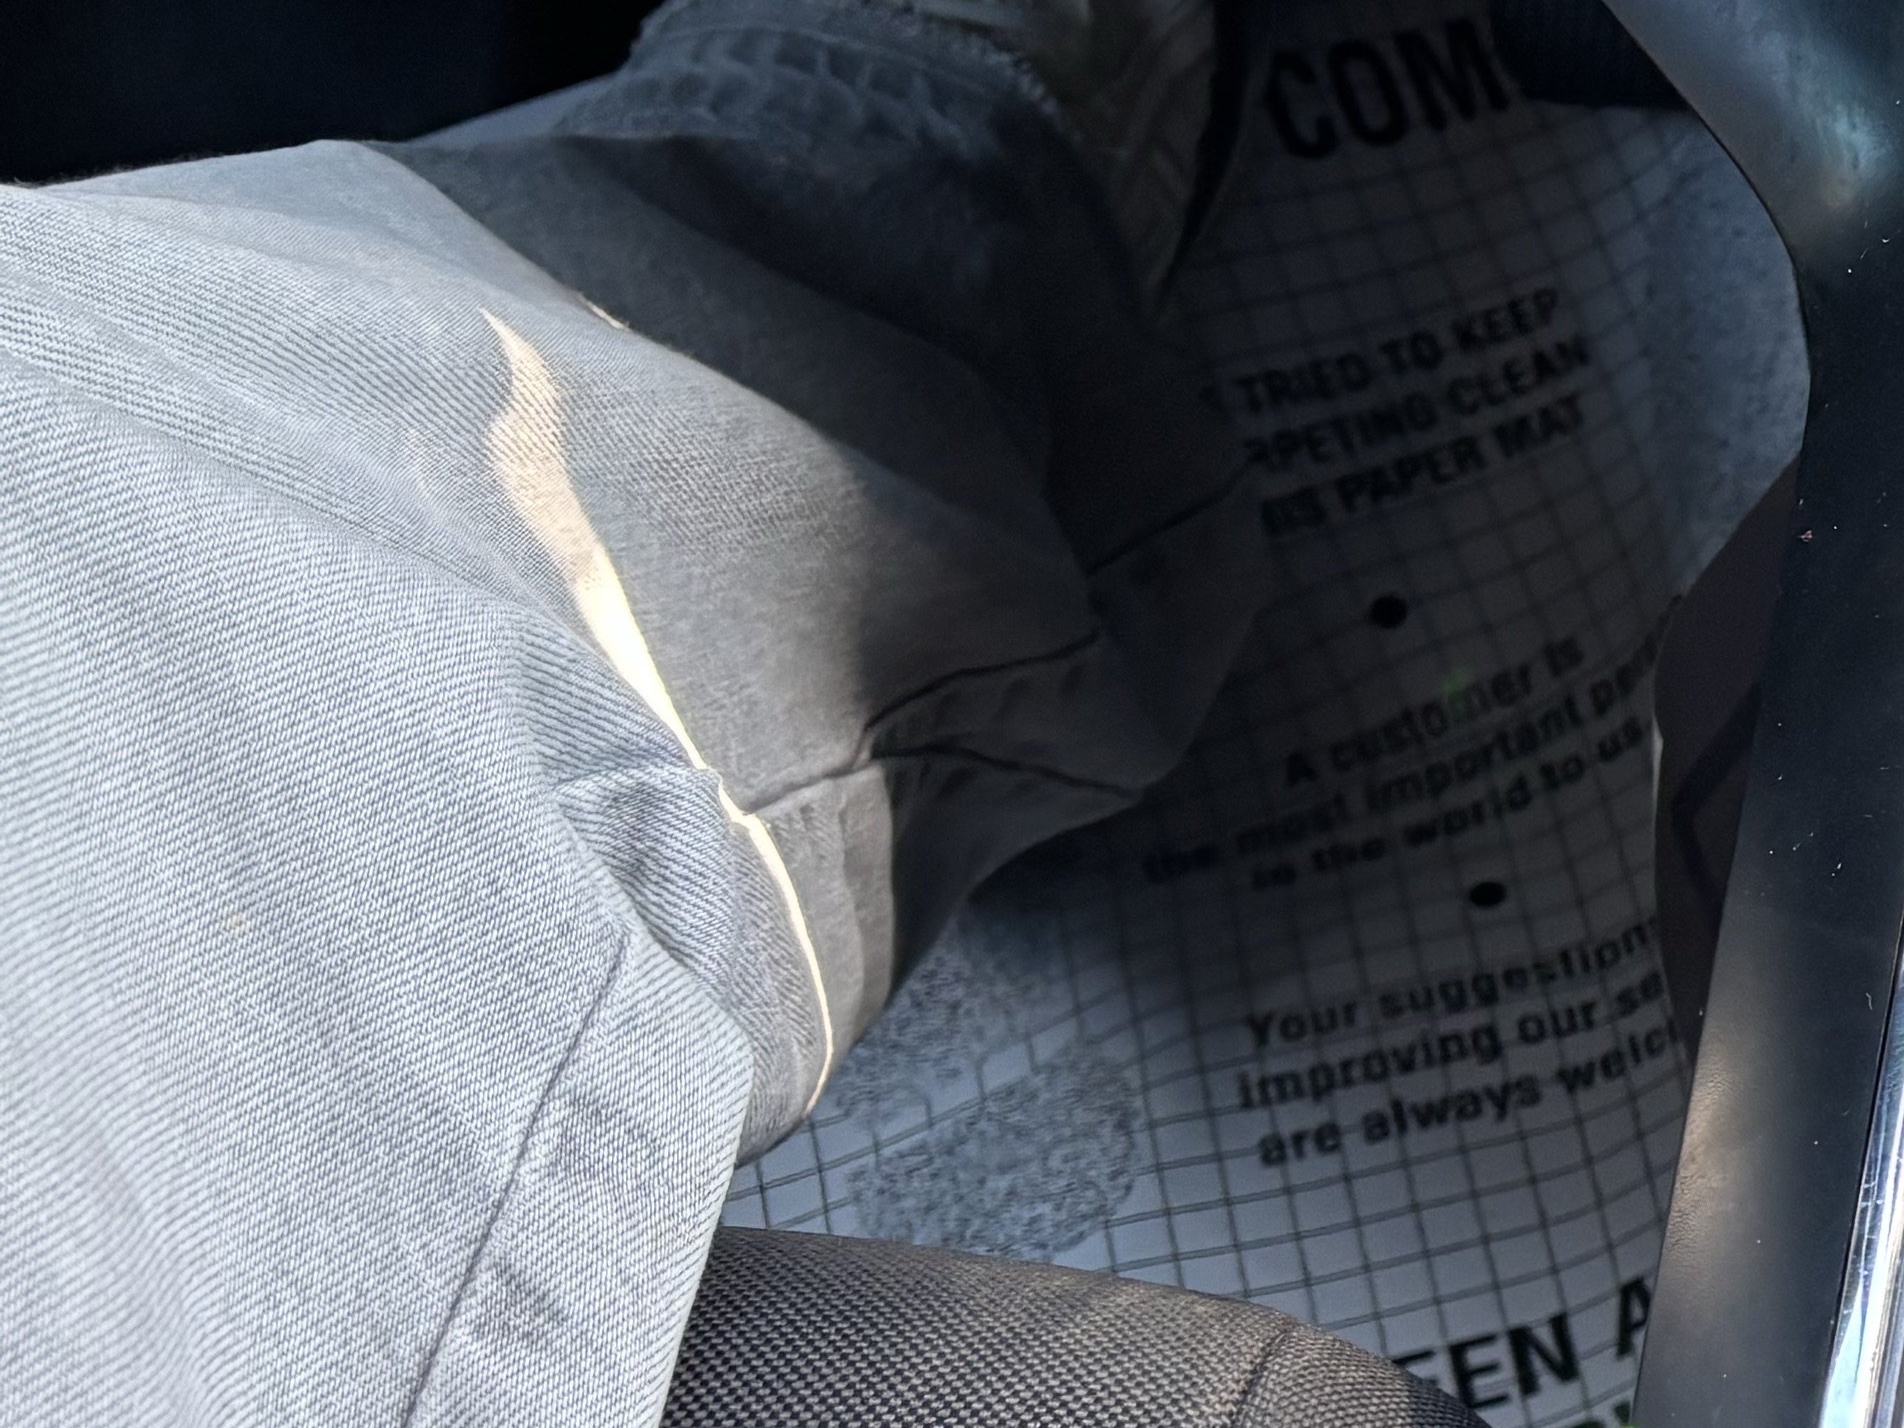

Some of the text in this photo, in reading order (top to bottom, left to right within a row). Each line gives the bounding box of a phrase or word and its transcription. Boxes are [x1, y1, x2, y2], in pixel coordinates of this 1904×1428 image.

[1231, 351, 1373, 416] TRIED
[1377, 329, 1446, 373] TO
[1450, 286, 1560, 349] KEEP
[1445, 334, 1592, 418] CLEAN
[1335, 436, 1487, 512] PAPER
[1492, 392, 1584, 459] MAT
[1329, 663, 1532, 773] customer
[1364, 694, 1583, 816] important
[1404, 774, 1532, 847] world
[1540, 756, 1585, 792] to
[1599, 716, 1644, 764] us
[1247, 920, 1655, 1047] Your suggestion
[1239, 1022, 1502, 1110] improving
[1517, 996, 1598, 1045] our
[1259, 1120, 1341, 1167] are
[1362, 1071, 1541, 1144] always
